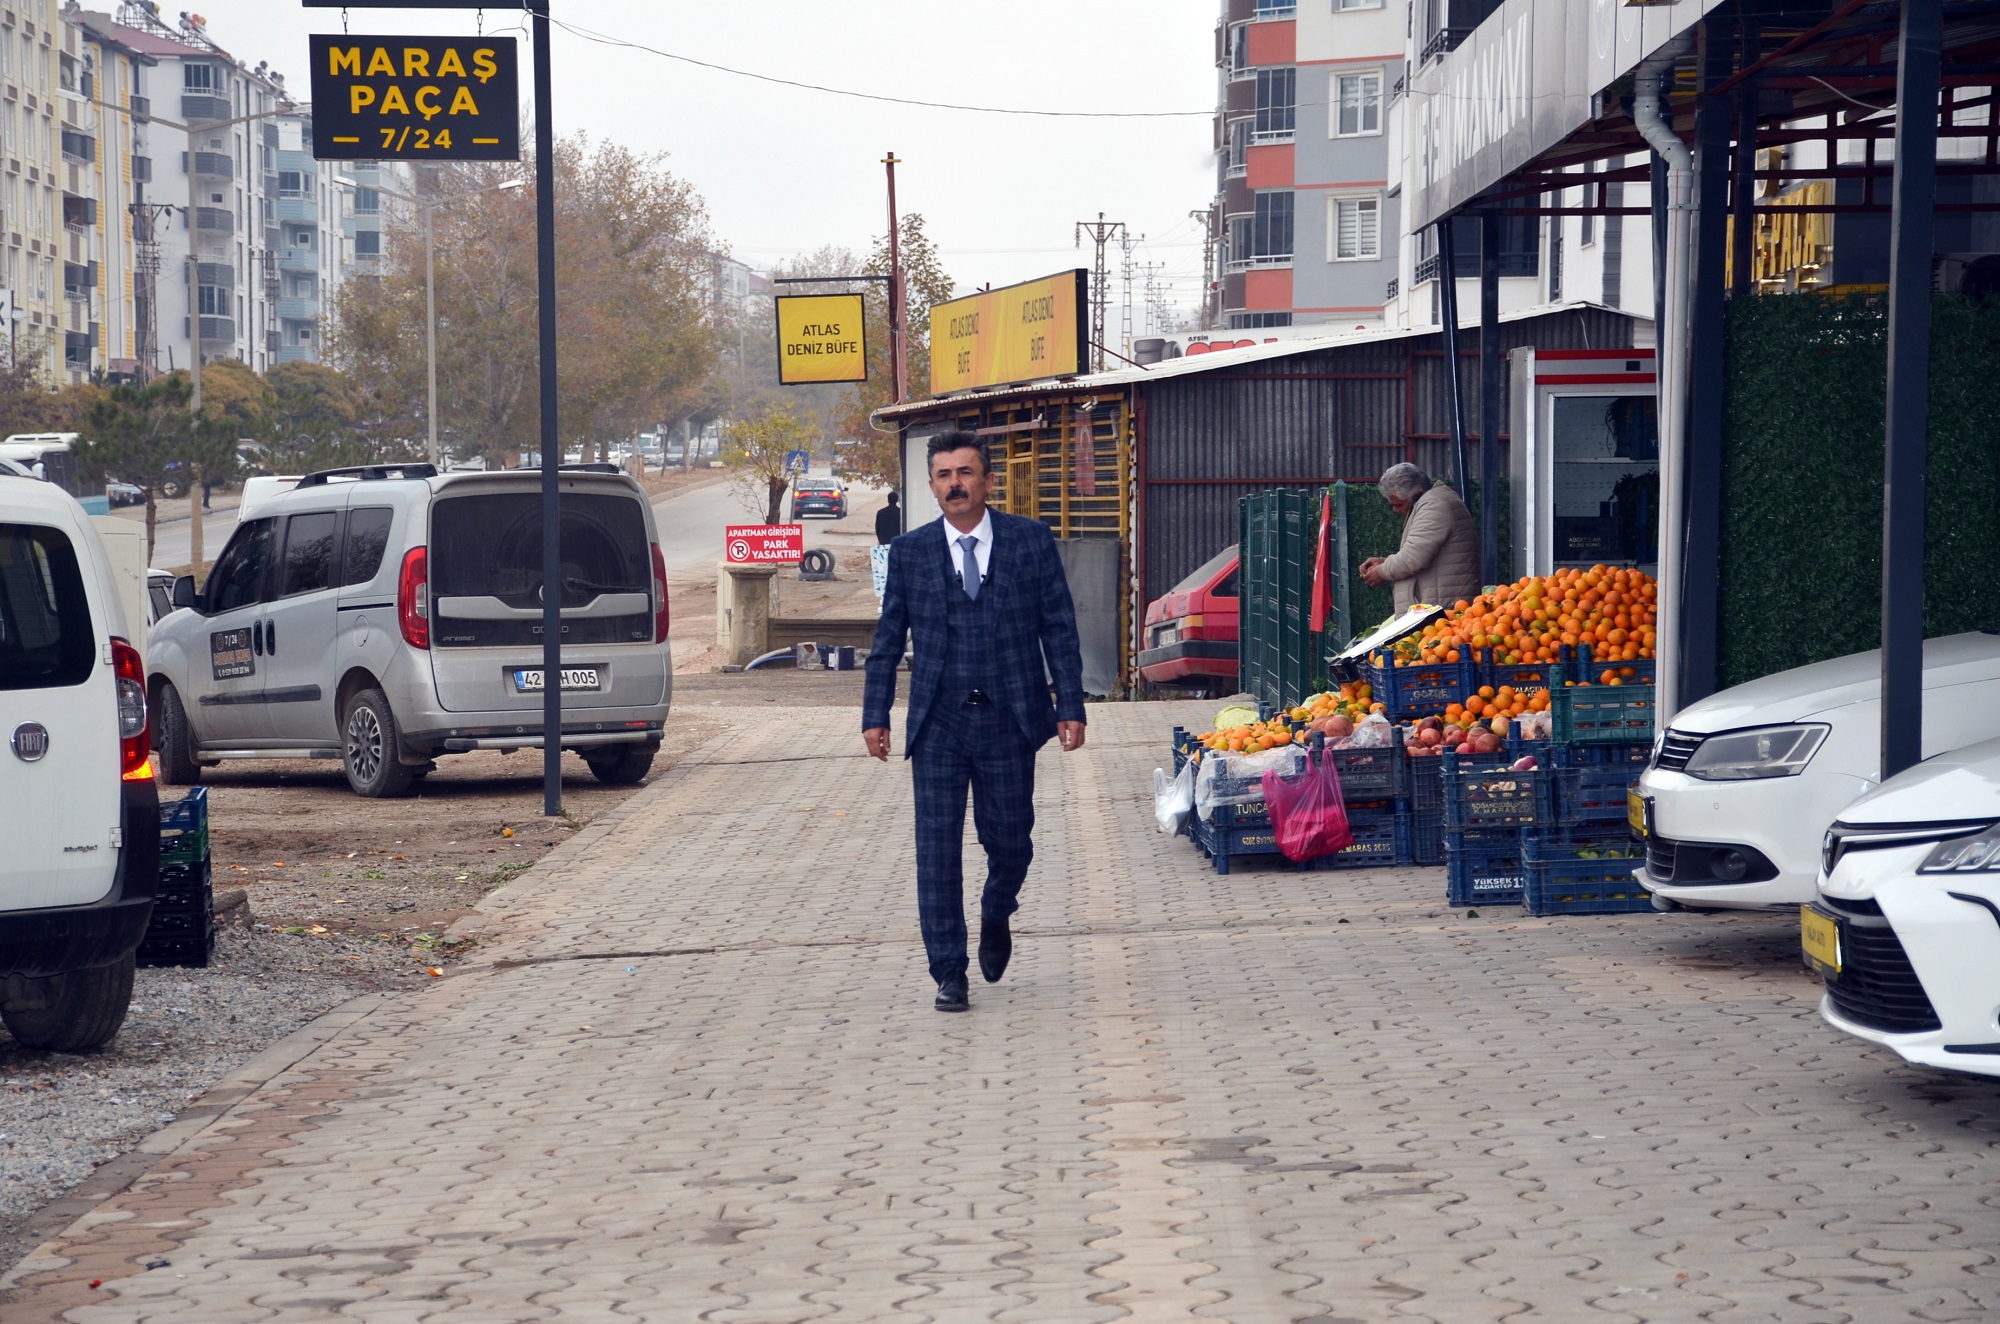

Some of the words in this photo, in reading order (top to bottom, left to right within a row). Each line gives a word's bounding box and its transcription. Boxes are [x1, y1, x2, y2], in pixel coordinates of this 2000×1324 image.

[329, 47, 498, 84] MARAŞ
[1453, 12, 1527, 168] MANAVI
[351, 85, 479, 121] PAÇA
[380, 126, 452, 151] 7/24
[1022, 298, 1037, 324] ATLAS
[1038, 290, 1054, 321] DENİZ
[802, 324, 841, 336] ATLAS
[950, 314, 964, 340] ATLAS
[965, 308, 979, 336] DENİZ
[787, 341, 823, 356] DENİZ
[826, 339, 858, 354] BÜFE
[1031, 332, 1045, 361] BÜFE
[958, 347, 970, 374] BÜFE
[728, 529, 767, 537] APARTMAN
[768, 526, 801, 539] GİRİŞİDİR
[763, 540, 789, 549] PARK
[751, 550, 801, 559] YASAKTIR!
[225, 634, 238, 647] 7/24
[525, 672, 541, 686] 42
[572, 671, 596, 685] 005
[20, 732, 41, 751] FIAT
[1473, 877, 1512, 885] YÜKSEK
